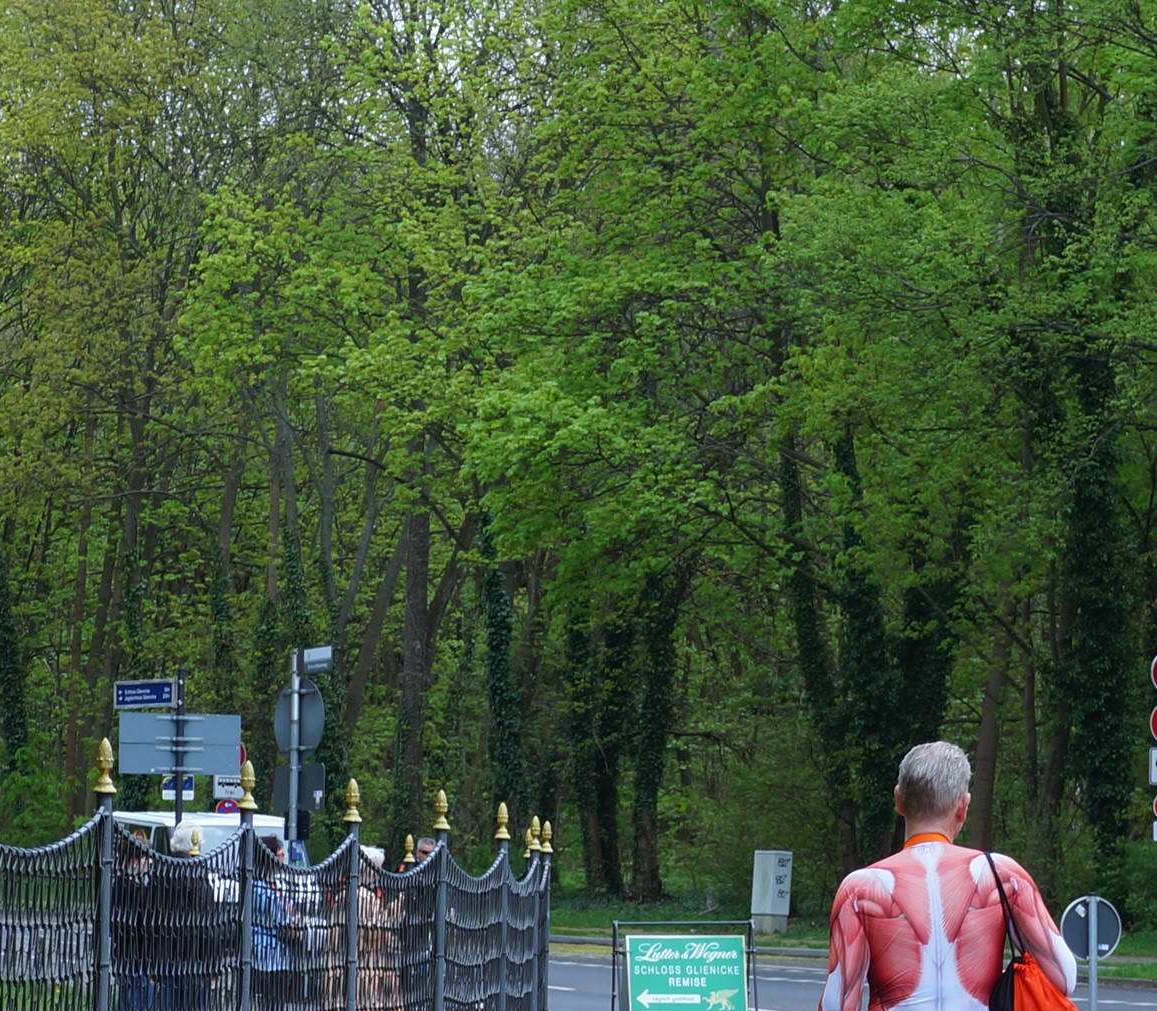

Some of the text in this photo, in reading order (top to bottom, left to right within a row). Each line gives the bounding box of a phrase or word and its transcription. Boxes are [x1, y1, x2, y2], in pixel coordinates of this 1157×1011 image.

[635, 942, 680, 962] Lutter
[685, 942, 738, 963] Wegner
[634, 965, 740, 975] SCHLOSS GLIENICKE
[668, 977, 707, 987] REMISE
